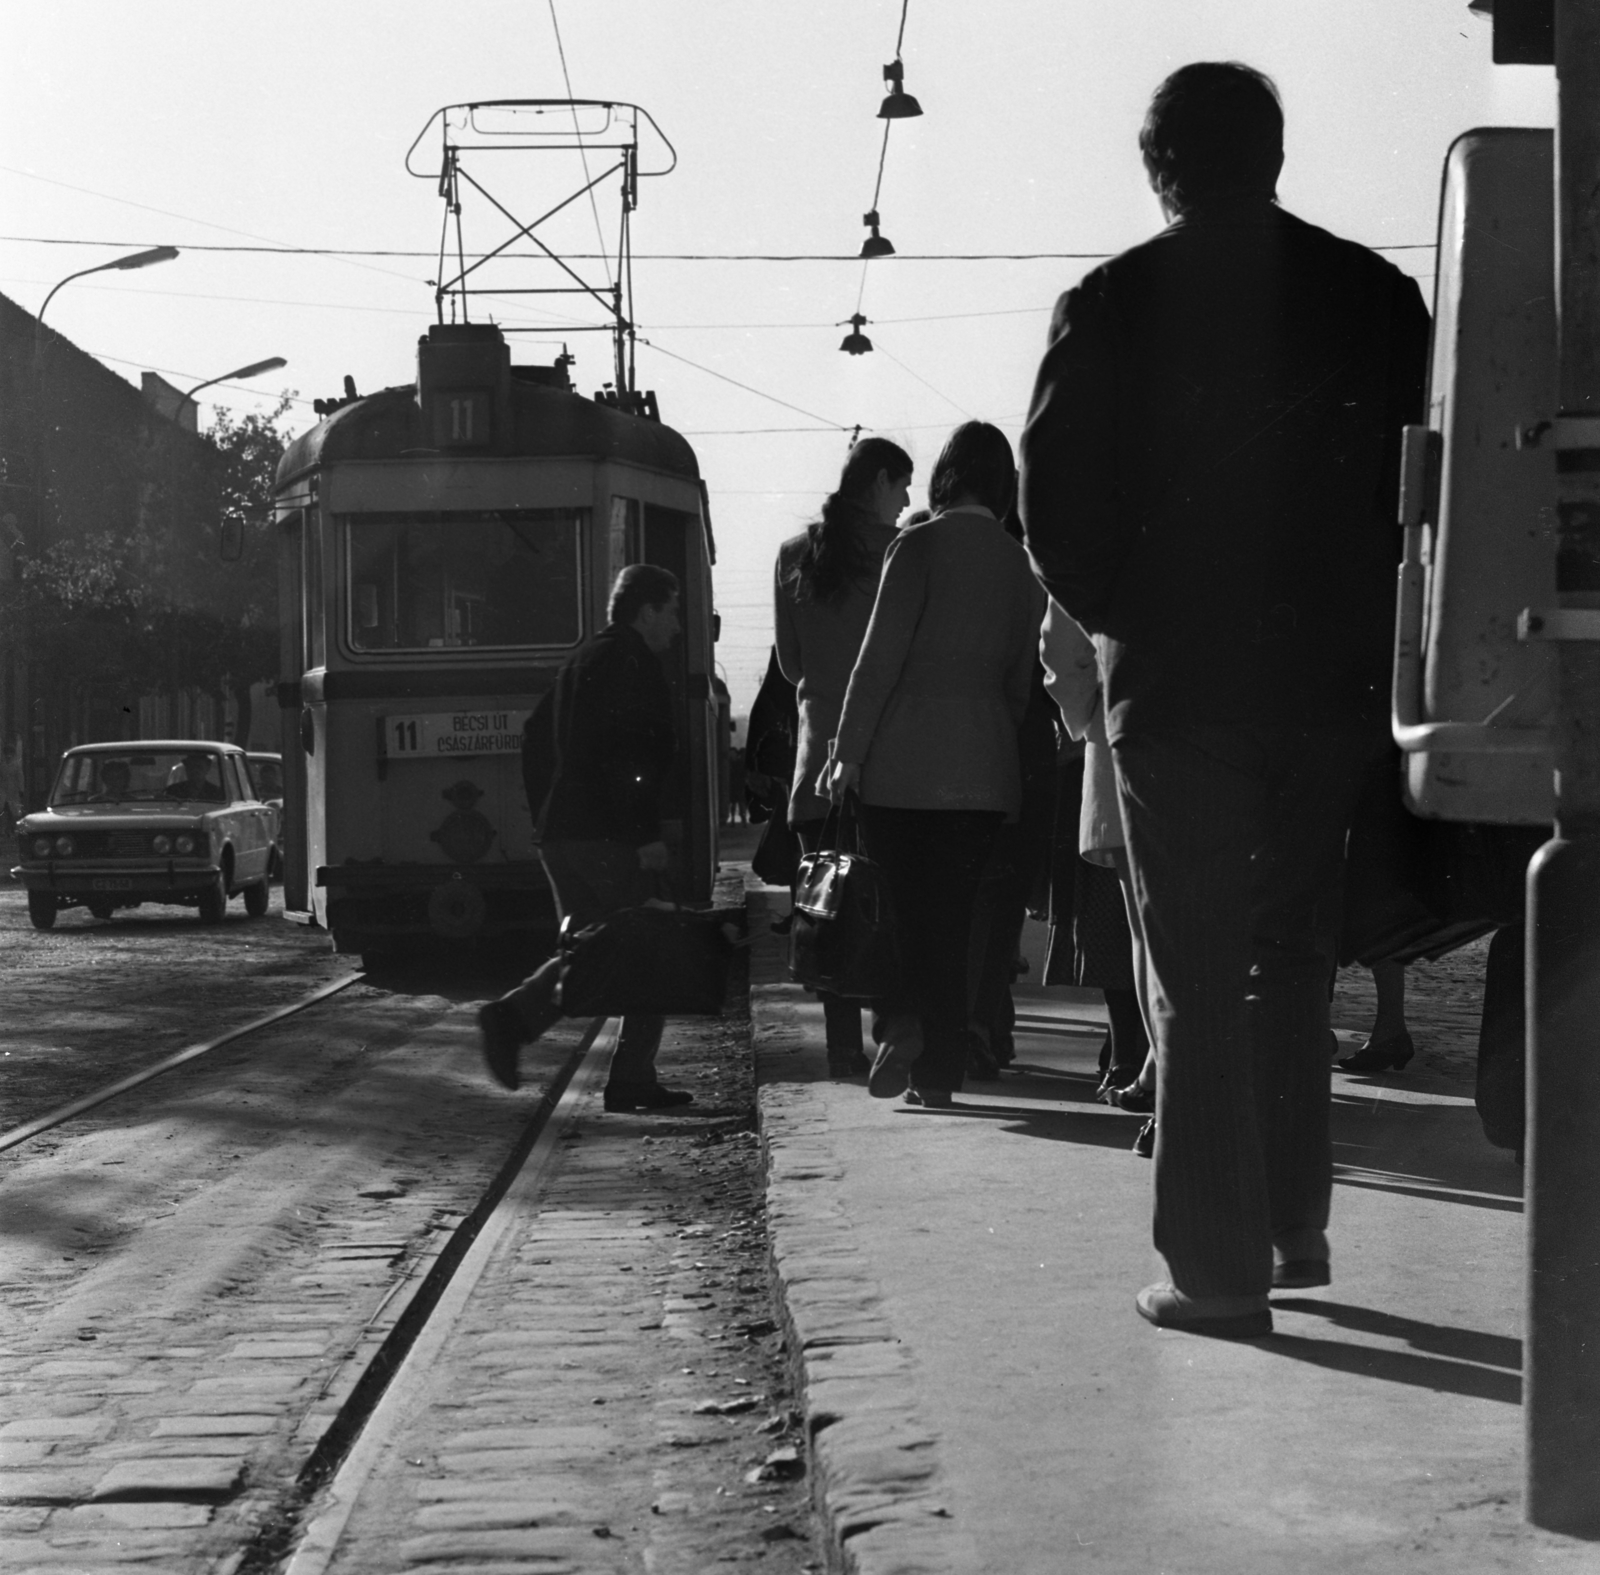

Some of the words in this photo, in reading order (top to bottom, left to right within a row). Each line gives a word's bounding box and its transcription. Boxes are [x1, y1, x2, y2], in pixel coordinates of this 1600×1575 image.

[450, 399, 473, 440] 11
[394, 720, 418, 751] 11
[453, 713, 489, 732] BÉCSI
